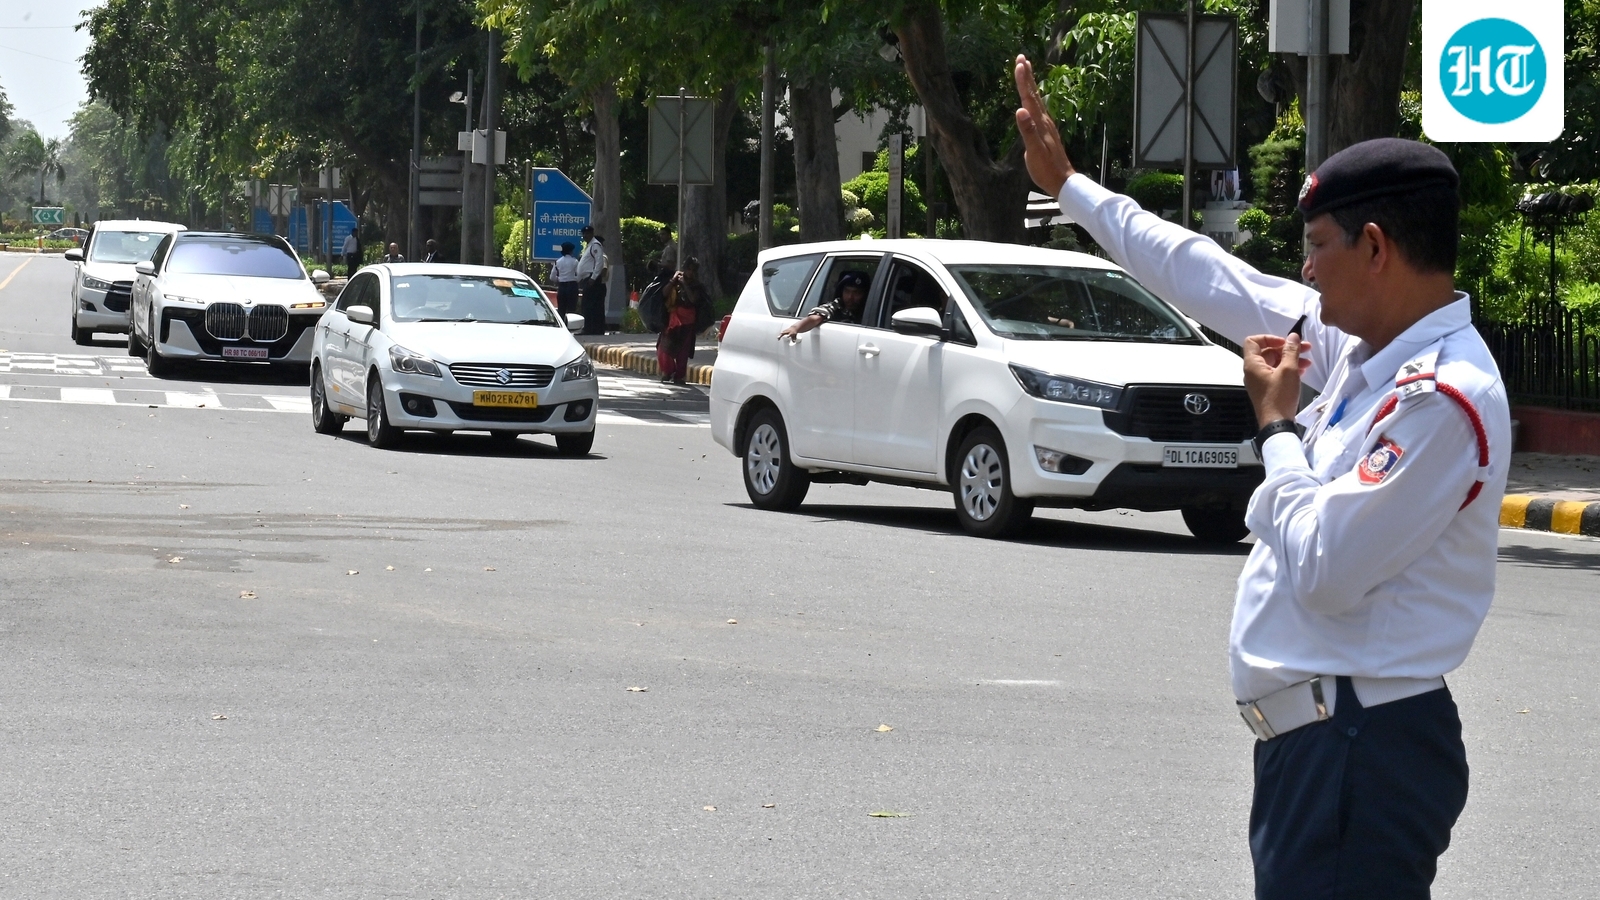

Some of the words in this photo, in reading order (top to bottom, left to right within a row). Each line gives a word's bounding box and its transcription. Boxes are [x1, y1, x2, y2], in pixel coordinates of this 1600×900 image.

[537, 228, 547, 236] LE
[552, 228, 583, 236] MERIDIE
[480, 393, 535, 405] MH02ER4781
[1171, 450, 1237, 464] DL1CAG9059
